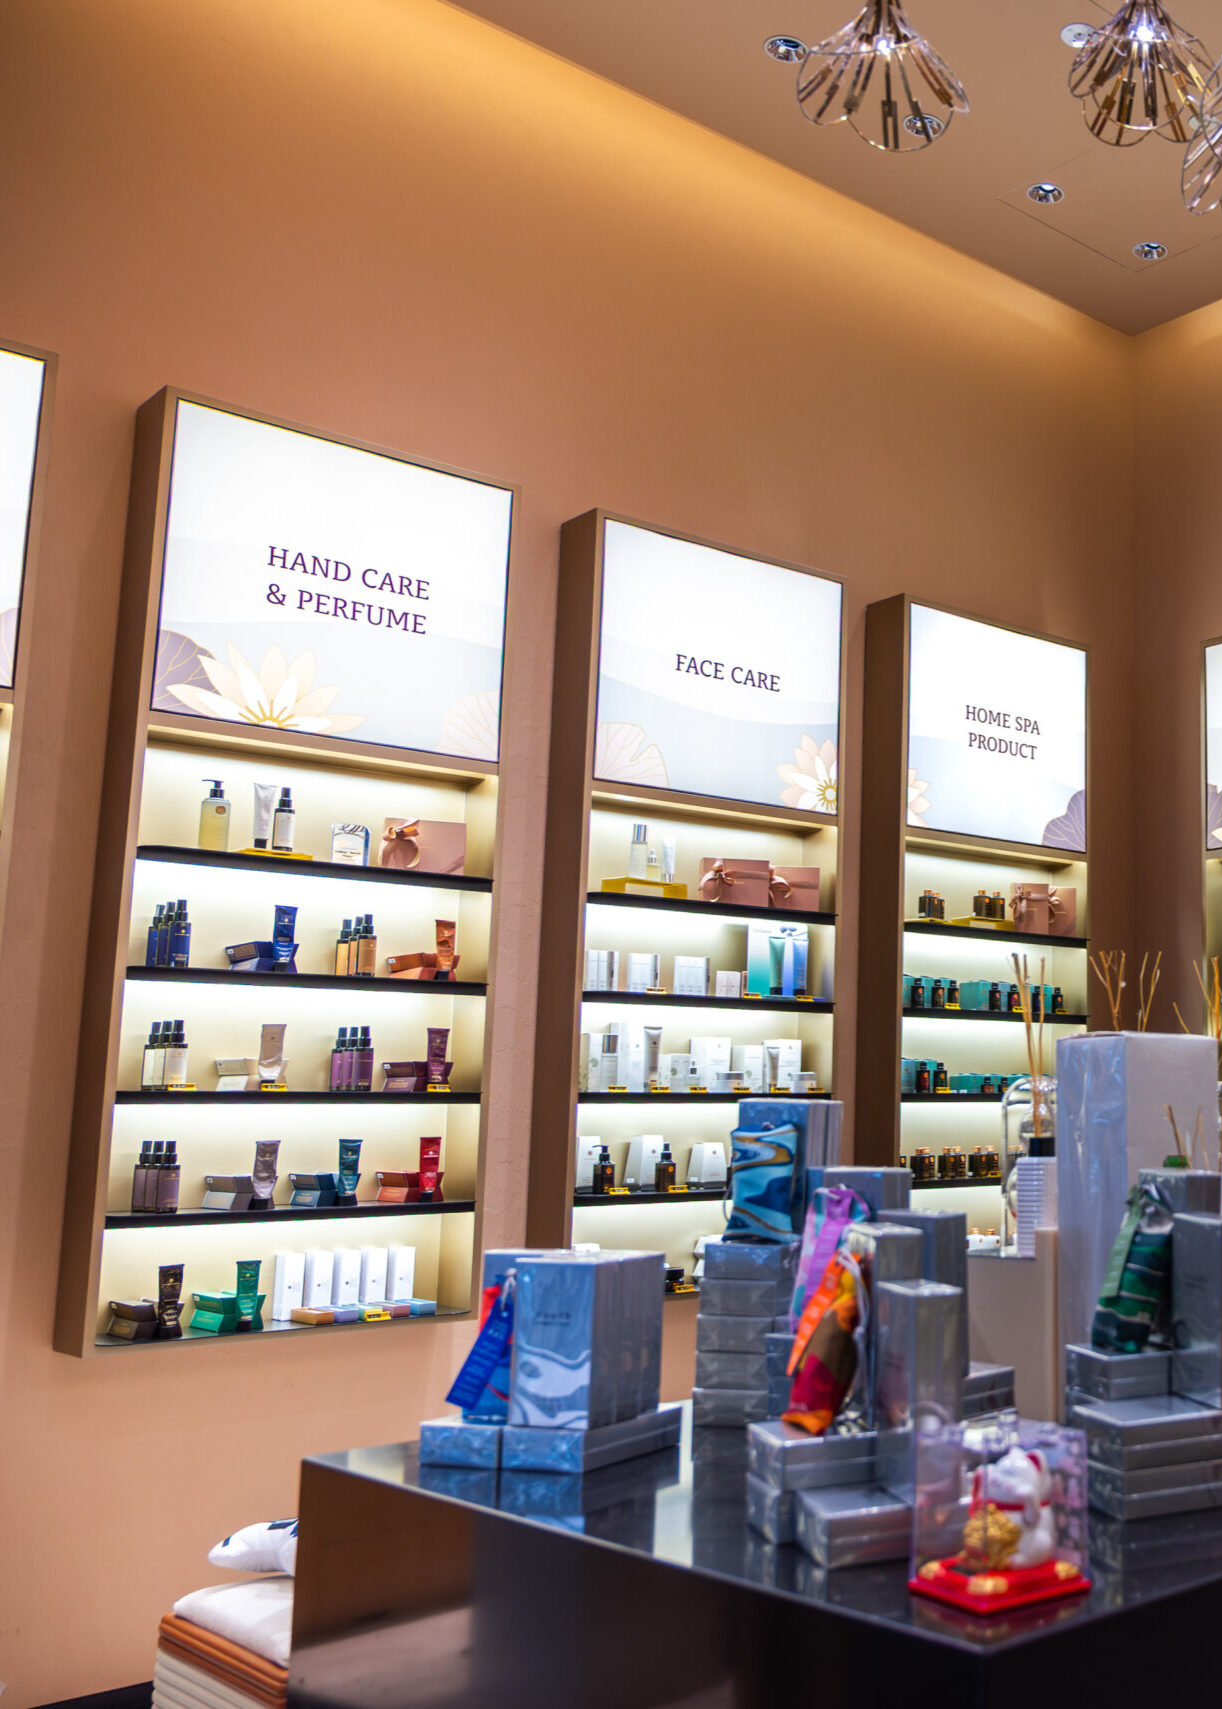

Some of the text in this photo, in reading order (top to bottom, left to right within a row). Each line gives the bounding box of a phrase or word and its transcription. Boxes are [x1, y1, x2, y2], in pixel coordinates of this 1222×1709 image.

[267, 545, 430, 601] HAND CARE
[266, 583, 427, 635] & PERFUME
[675, 653, 781, 693] FACE CARE
[965, 704, 1041, 736] HOME SPA
[968, 732, 1038, 760] PRODUCT
